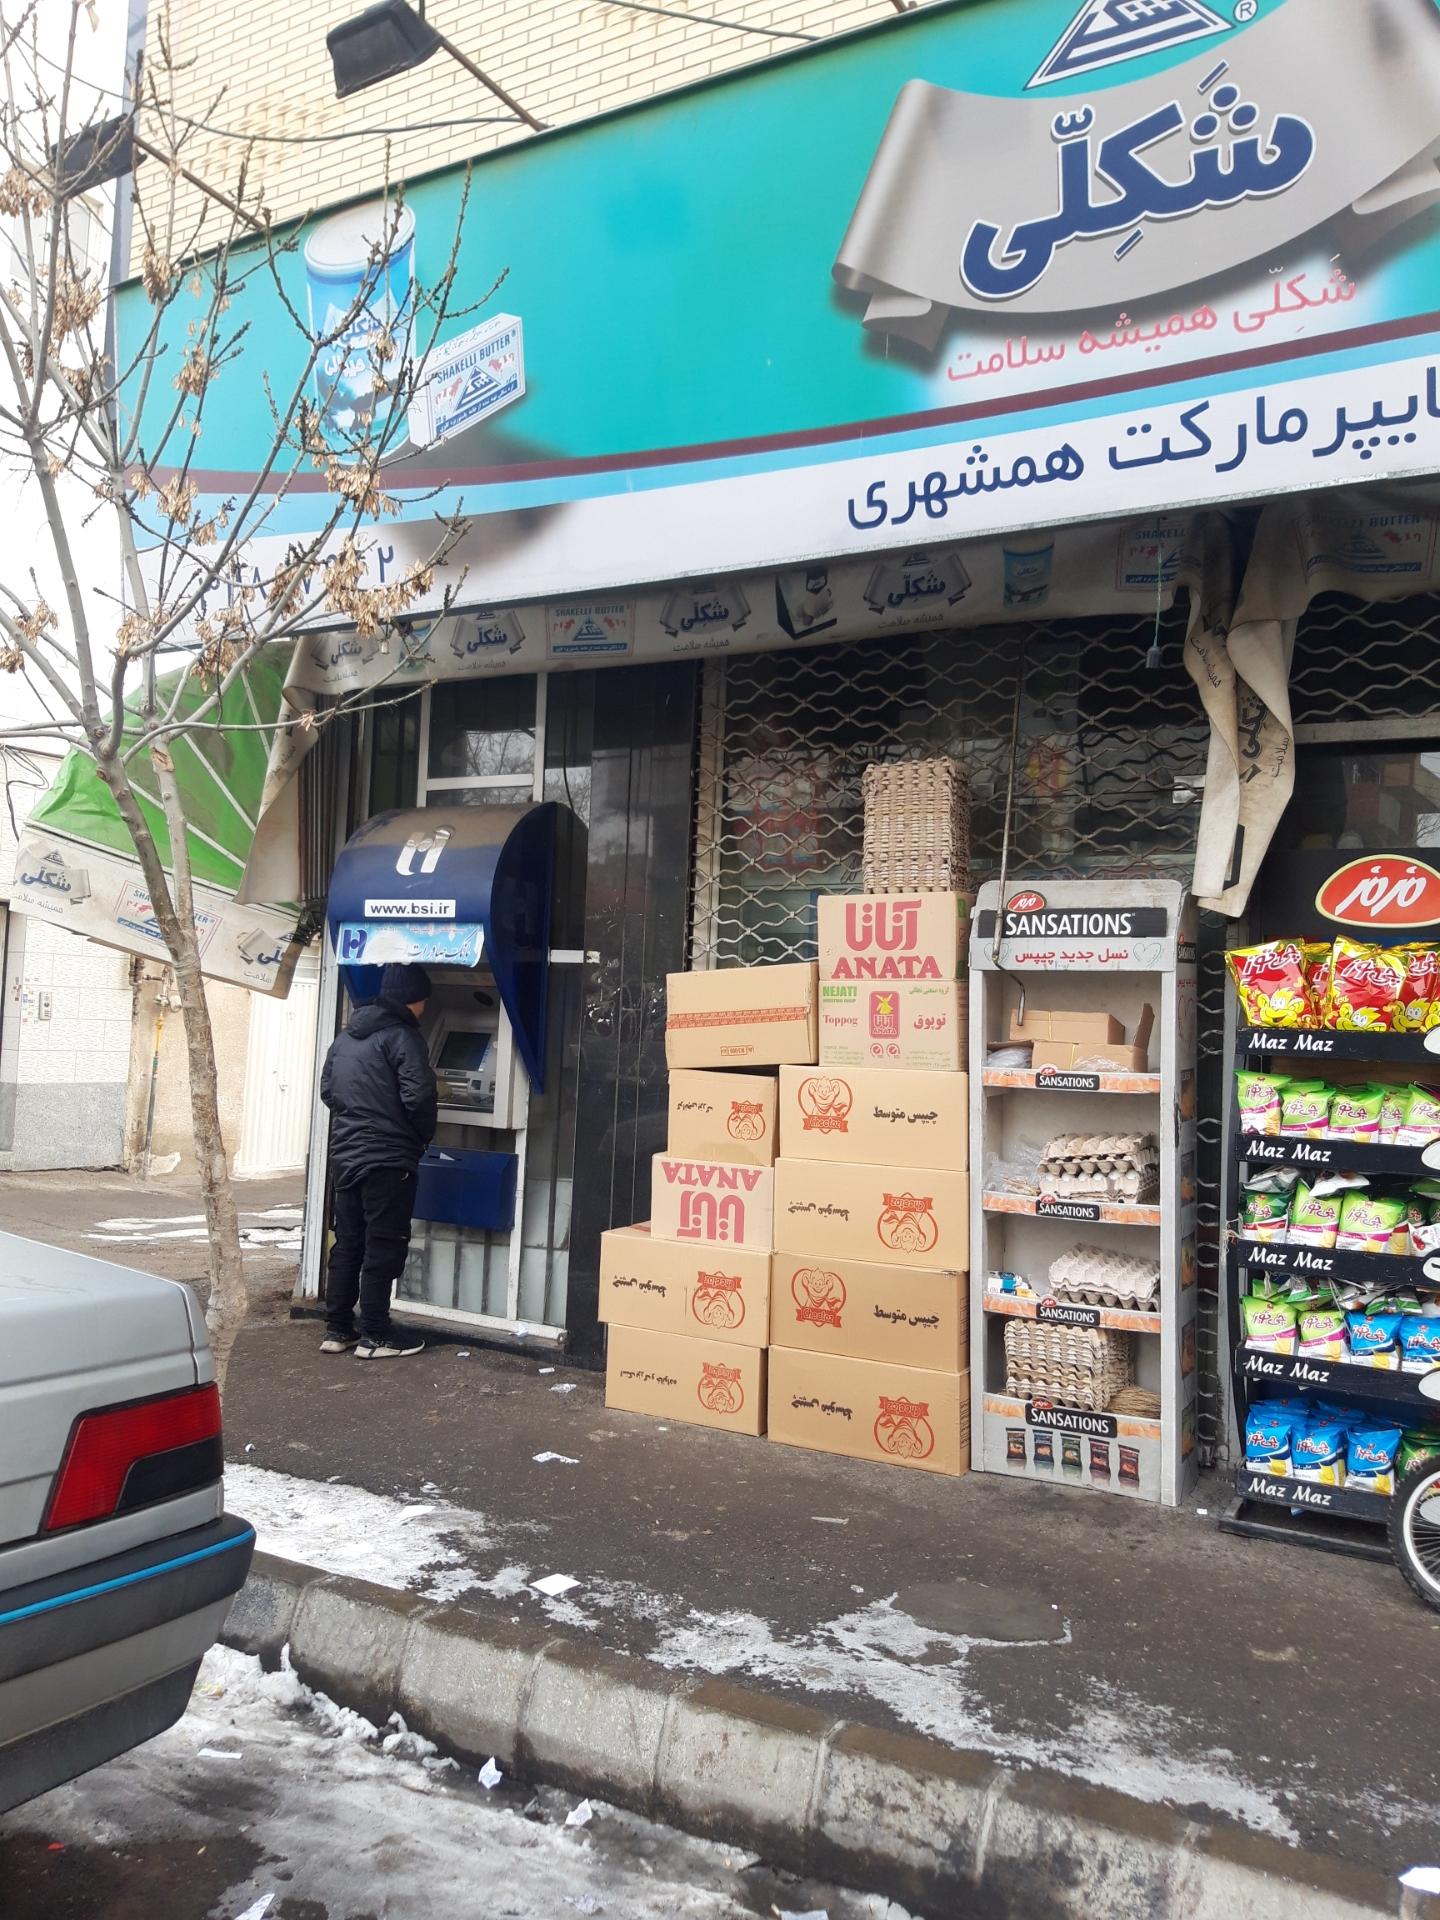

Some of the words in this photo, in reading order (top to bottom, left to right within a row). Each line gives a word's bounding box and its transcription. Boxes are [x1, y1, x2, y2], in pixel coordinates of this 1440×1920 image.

[1078, 304, 1218, 354] همیشه
[437, 353, 477, 384] SHAKELLI
[480, 334, 510, 361] BUTTER
[947, 335, 1065, 382] سلامت
[847, 442, 1085, 530] همشهری
[371, 902, 450, 915] www.bsi.ir
[1005, 912, 1132, 936] SANSATIONS
[1015, 949, 1056, 965] چیپس
[1059, 949, 1094, 964] جدید
[1098, 947, 1129, 963] نسل
[831, 955, 943, 980] ANATA
[823, 985, 858, 997] NEJATI
[1248, 1033, 1288, 1050] Maz
[1293, 1034, 1334, 1051] Maz
[1039, 1075, 1095, 1088] SANSATIONS
[873, 1106, 906, 1122] متوسط
[907, 1111, 938, 1125] چیپس
[1246, 1140, 1286, 1159] Maz
[1291, 1143, 1331, 1162] Maz
[661, 1161, 763, 1191] ANATA
[818, 1203, 850, 1221] متوسط
[1038, 1202, 1095, 1218] SANSATIONS
[1248, 1247, 1288, 1266] Maz
[1293, 1251, 1334, 1271] Maz
[873, 1304, 907, 1324] متوسط
[908, 1314, 940, 1329] چیپس
[1039, 1306, 1095, 1324] SANSATIONS
[1244, 1355, 1284, 1375] Maz
[1289, 1362, 1330, 1382] Maz
[821, 1401, 853, 1421] متوسط
[1031, 1408, 1110, 1434] SANSATIONS
[1248, 1477, 1285, 1497] Maz
[1292, 1485, 1332, 1506] Maz
